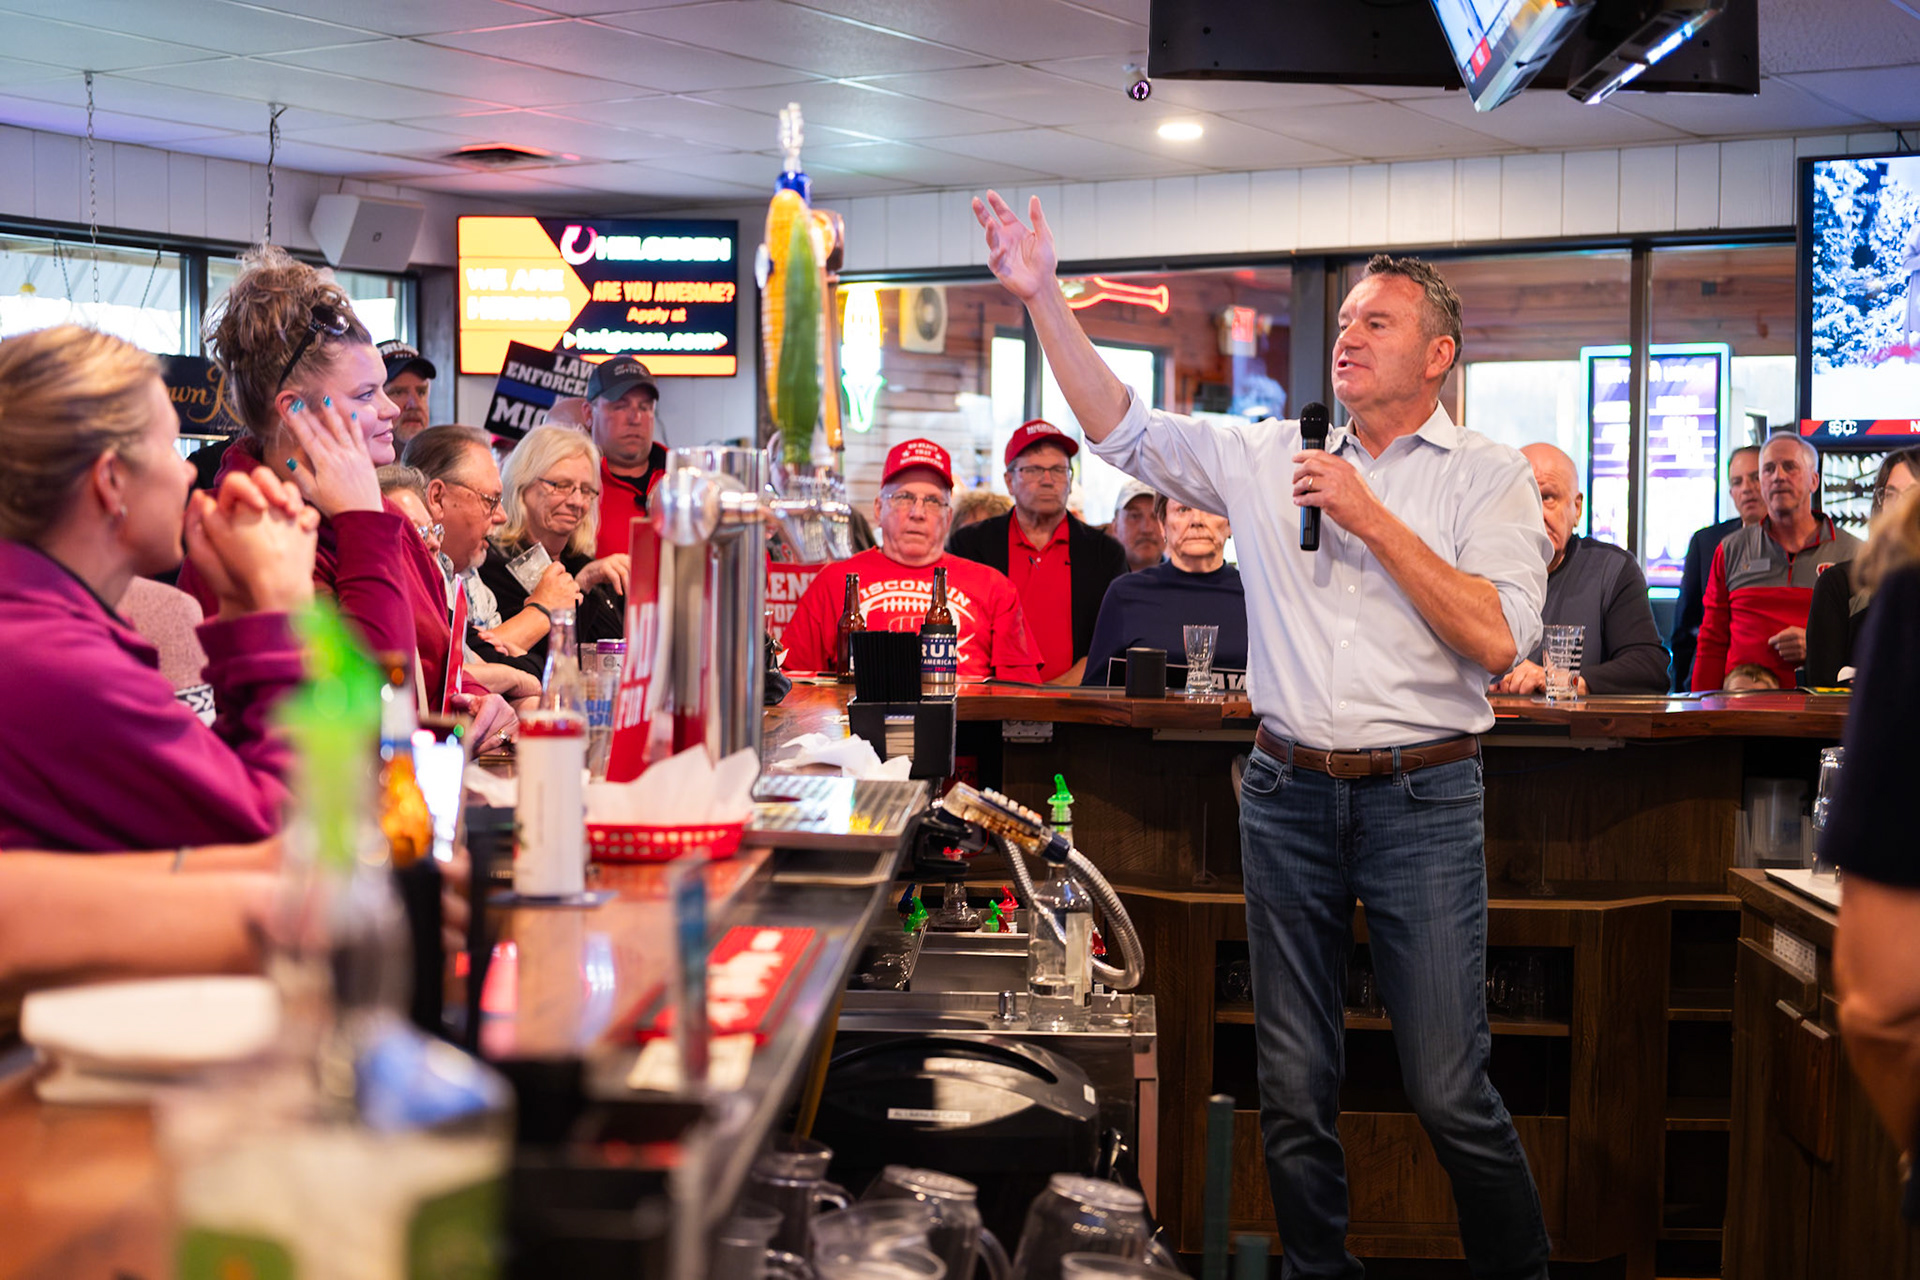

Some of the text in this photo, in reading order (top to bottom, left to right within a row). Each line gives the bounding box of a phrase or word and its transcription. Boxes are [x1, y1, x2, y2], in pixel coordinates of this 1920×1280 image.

[593, 281, 735, 303] ARE YOU AWESOME?
[627, 307, 686, 324] Apply at
[505, 361, 590, 396] ENFORCE
[553, 355, 597, 379] LAW
[860, 579, 971, 608] ISCONIN
